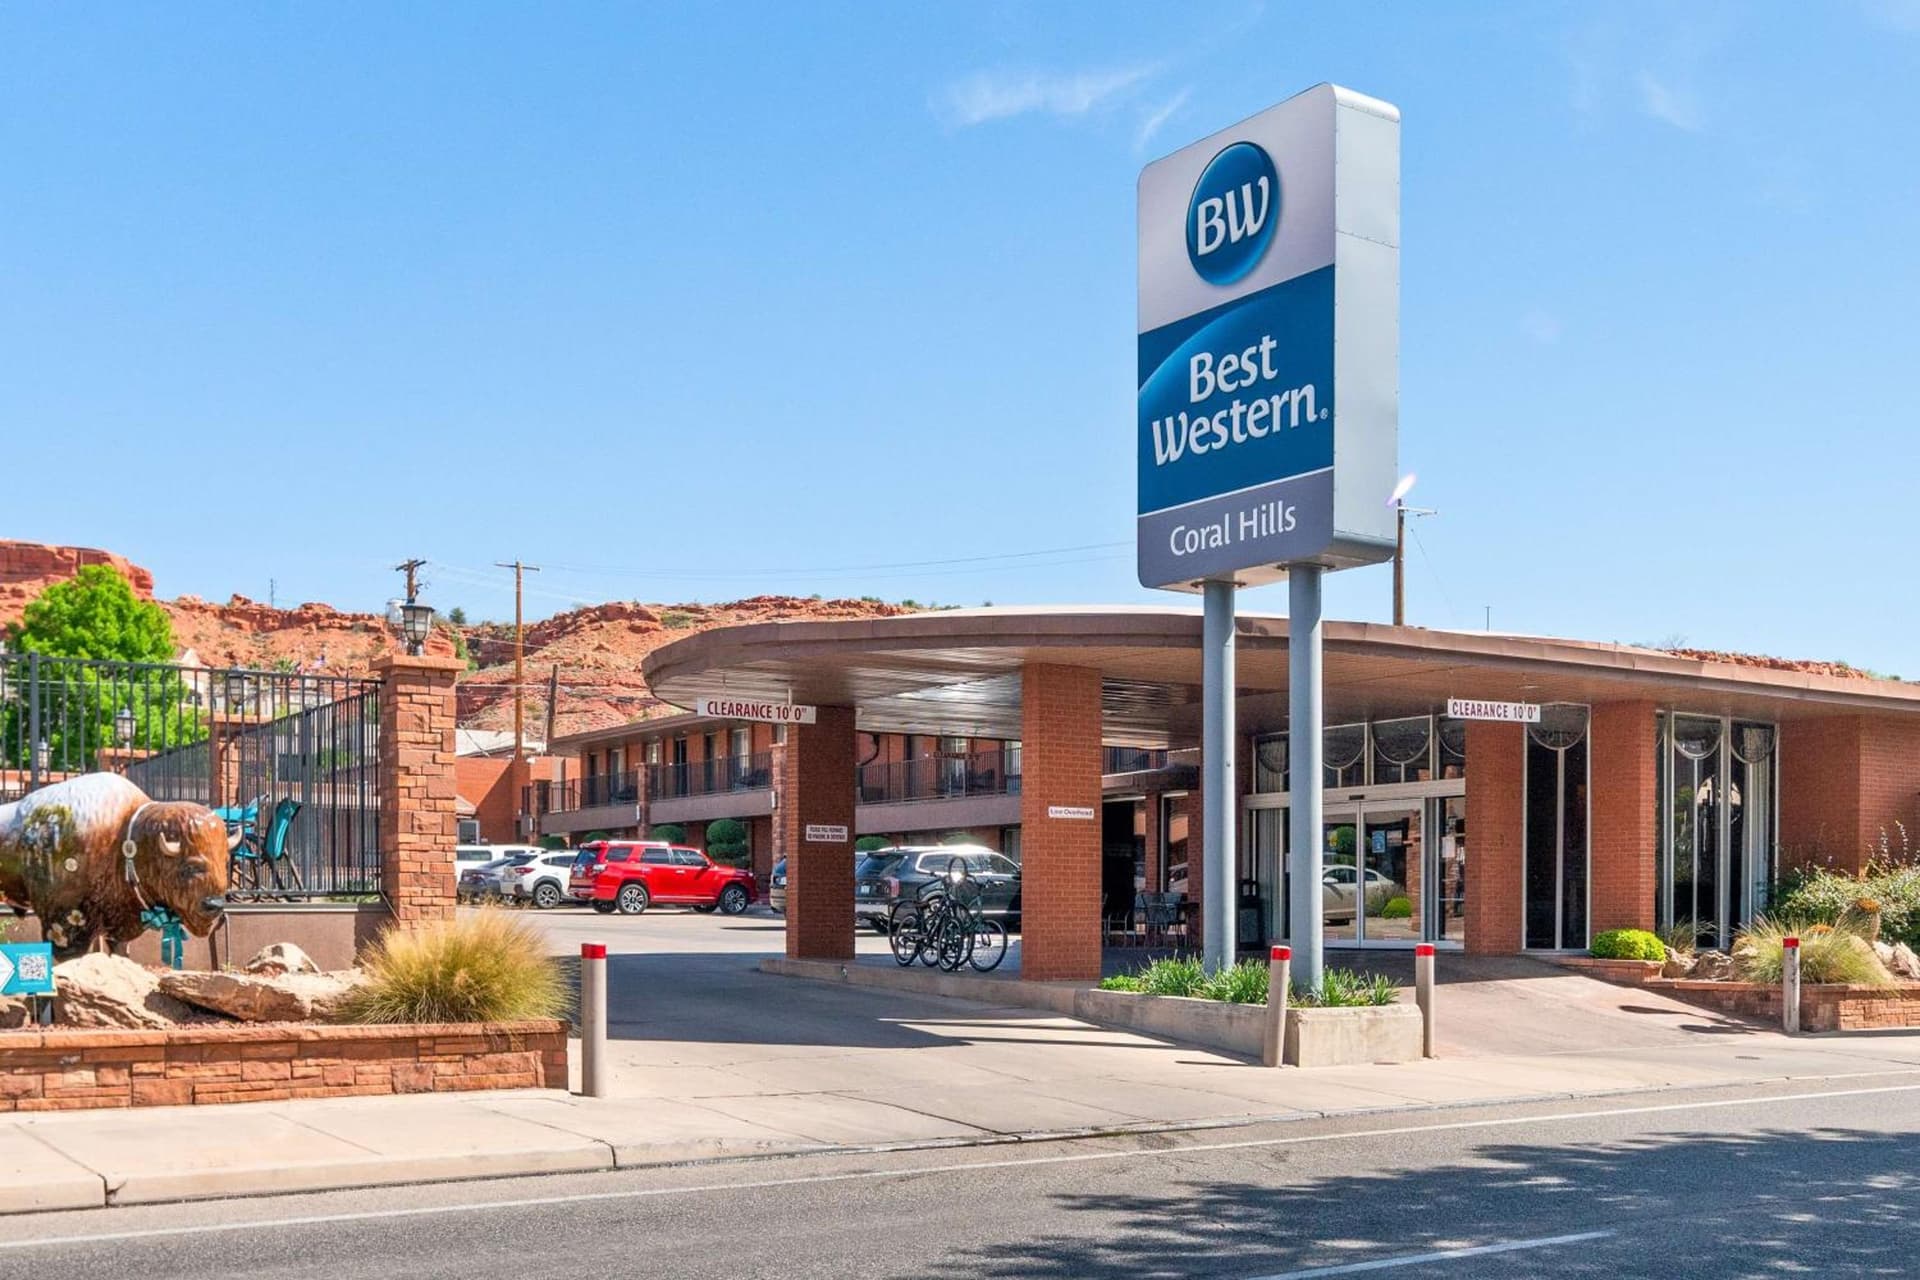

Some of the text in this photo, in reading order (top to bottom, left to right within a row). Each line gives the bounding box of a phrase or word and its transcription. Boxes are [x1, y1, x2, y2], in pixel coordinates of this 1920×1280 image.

[1198, 175, 1269, 256] BW
[1190, 335, 1278, 403] Best
[1170, 500, 1296, 556] Coral Hills
[707, 701, 773, 719] CLEARANCE
[1452, 701, 1508, 718] CLEARANCE
